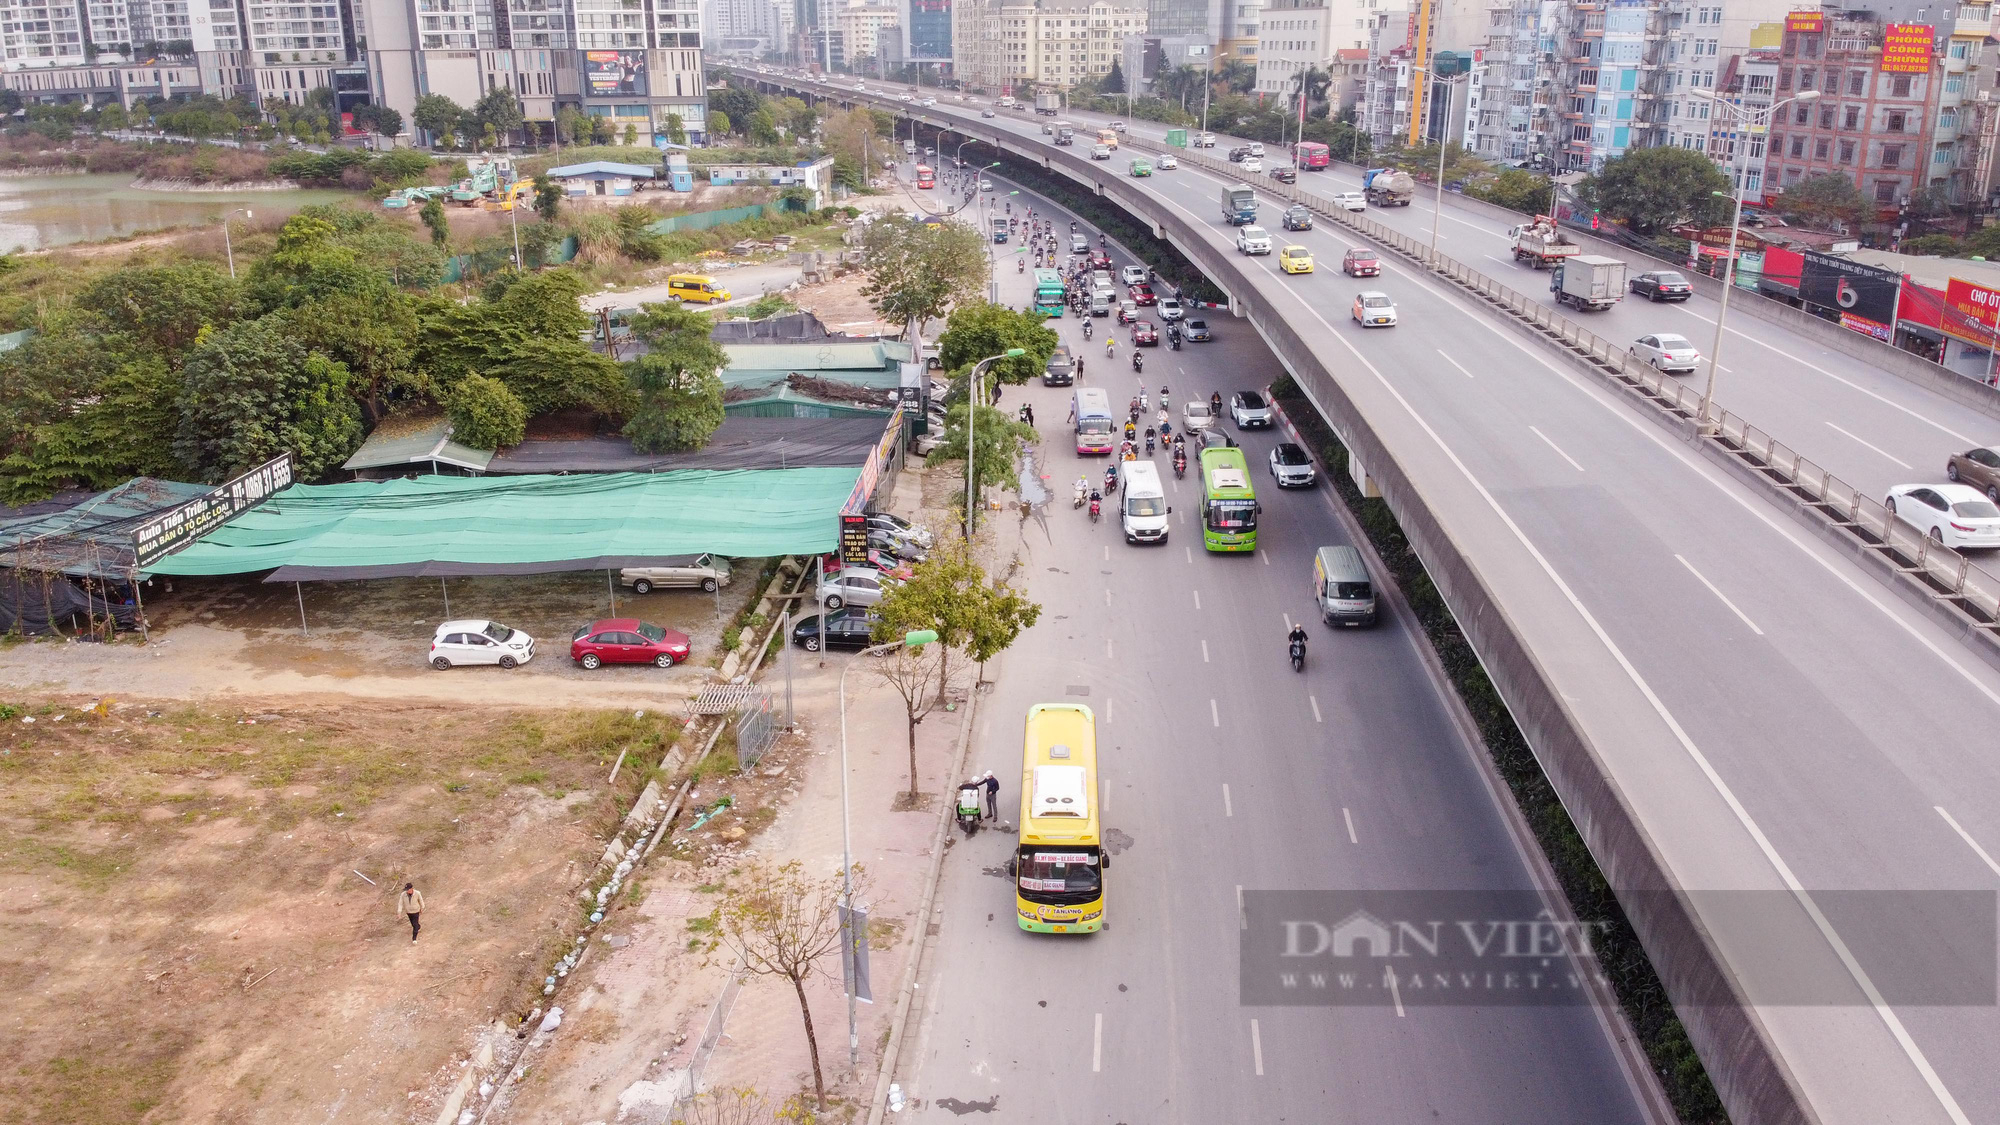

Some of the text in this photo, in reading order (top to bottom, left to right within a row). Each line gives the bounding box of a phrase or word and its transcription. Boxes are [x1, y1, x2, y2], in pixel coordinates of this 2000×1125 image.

[1898, 25, 1925, 34] VĂN
[1886, 35, 1931, 44] PHÒNG
[1888, 45, 1925, 54] CÔNG
[1884, 54, 1929, 64] CHỨNG
[1970, 288, 1988, 306] CHỢ
[1957, 302, 1998, 322] MUA BÁN TR
[139, 525, 161, 543] Auto
[163, 511, 184, 531] Tiến
[185, 498, 208, 519] Triển
[263, 467, 273, 495] 31
[272, 457, 291, 489] 5555
[138, 541, 158, 556] MUA
[159, 529, 176, 545] BÁN
[177, 525, 184, 535] Ô
[184, 519, 195, 531] TÔ
[196, 510, 212, 525] CÁC
